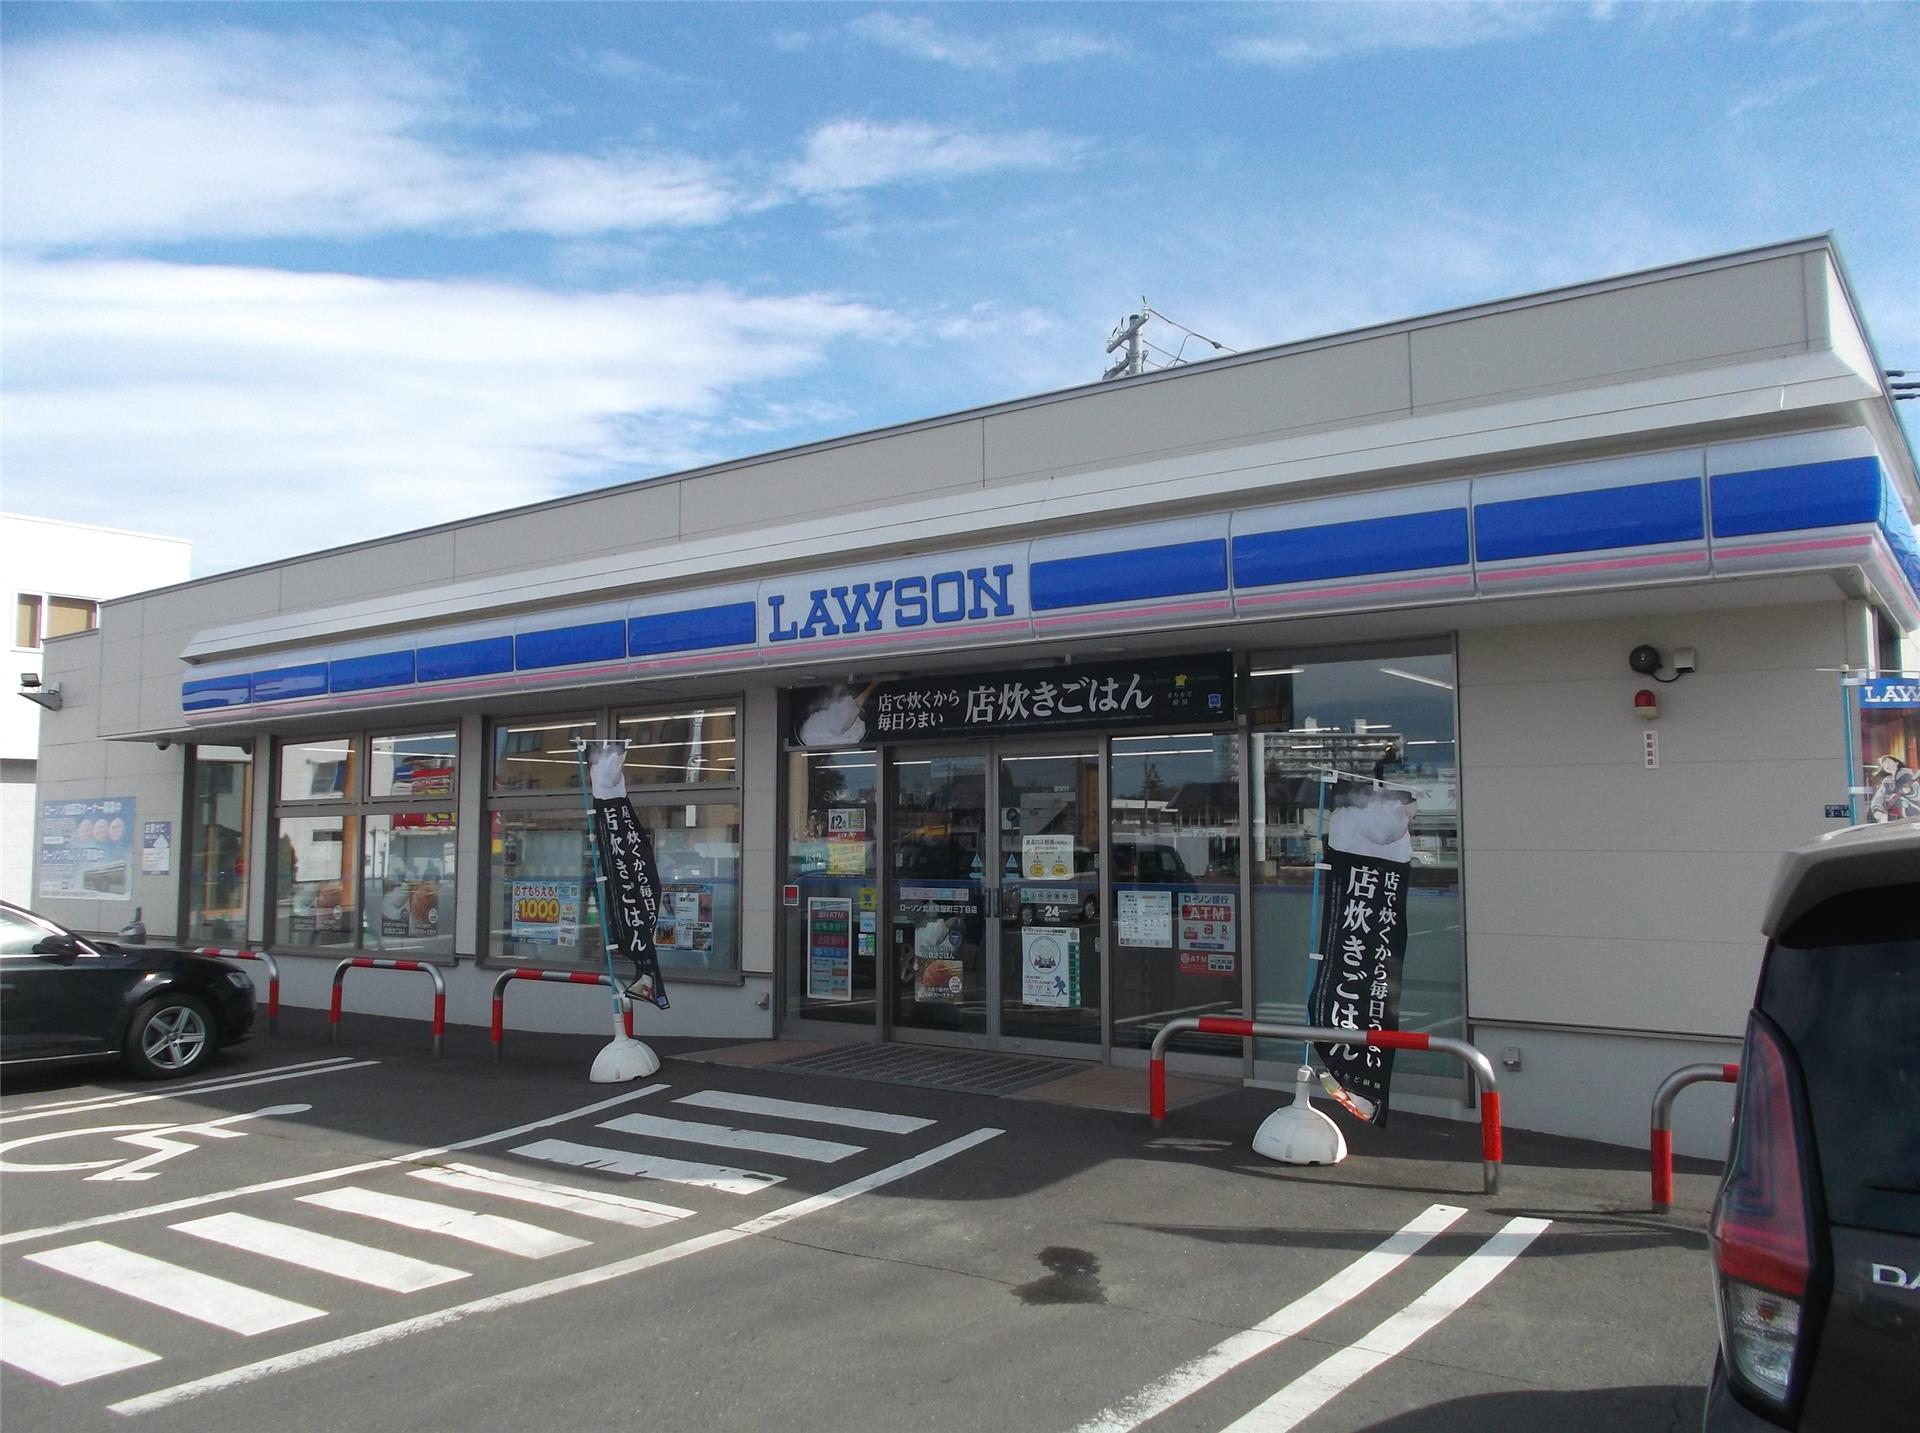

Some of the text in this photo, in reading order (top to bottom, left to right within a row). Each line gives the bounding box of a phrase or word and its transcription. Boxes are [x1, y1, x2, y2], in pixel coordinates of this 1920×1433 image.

[767, 563, 1014, 642] LAWSON
[878, 672, 1154, 724] 店で炊くから 店炊きごはん
[877, 711, 944, 731] 毎日うまい
[621, 805, 658, 934] 店で炊くから毎日う
[1184, 895, 1229, 904] ローソン銀行
[1044, 905, 1060, 917] 24
[1190, 906, 1225, 920] ATM
[1190, 955, 1207, 963] ATM
[1328, 864, 1380, 1063] 店炊きごはん
